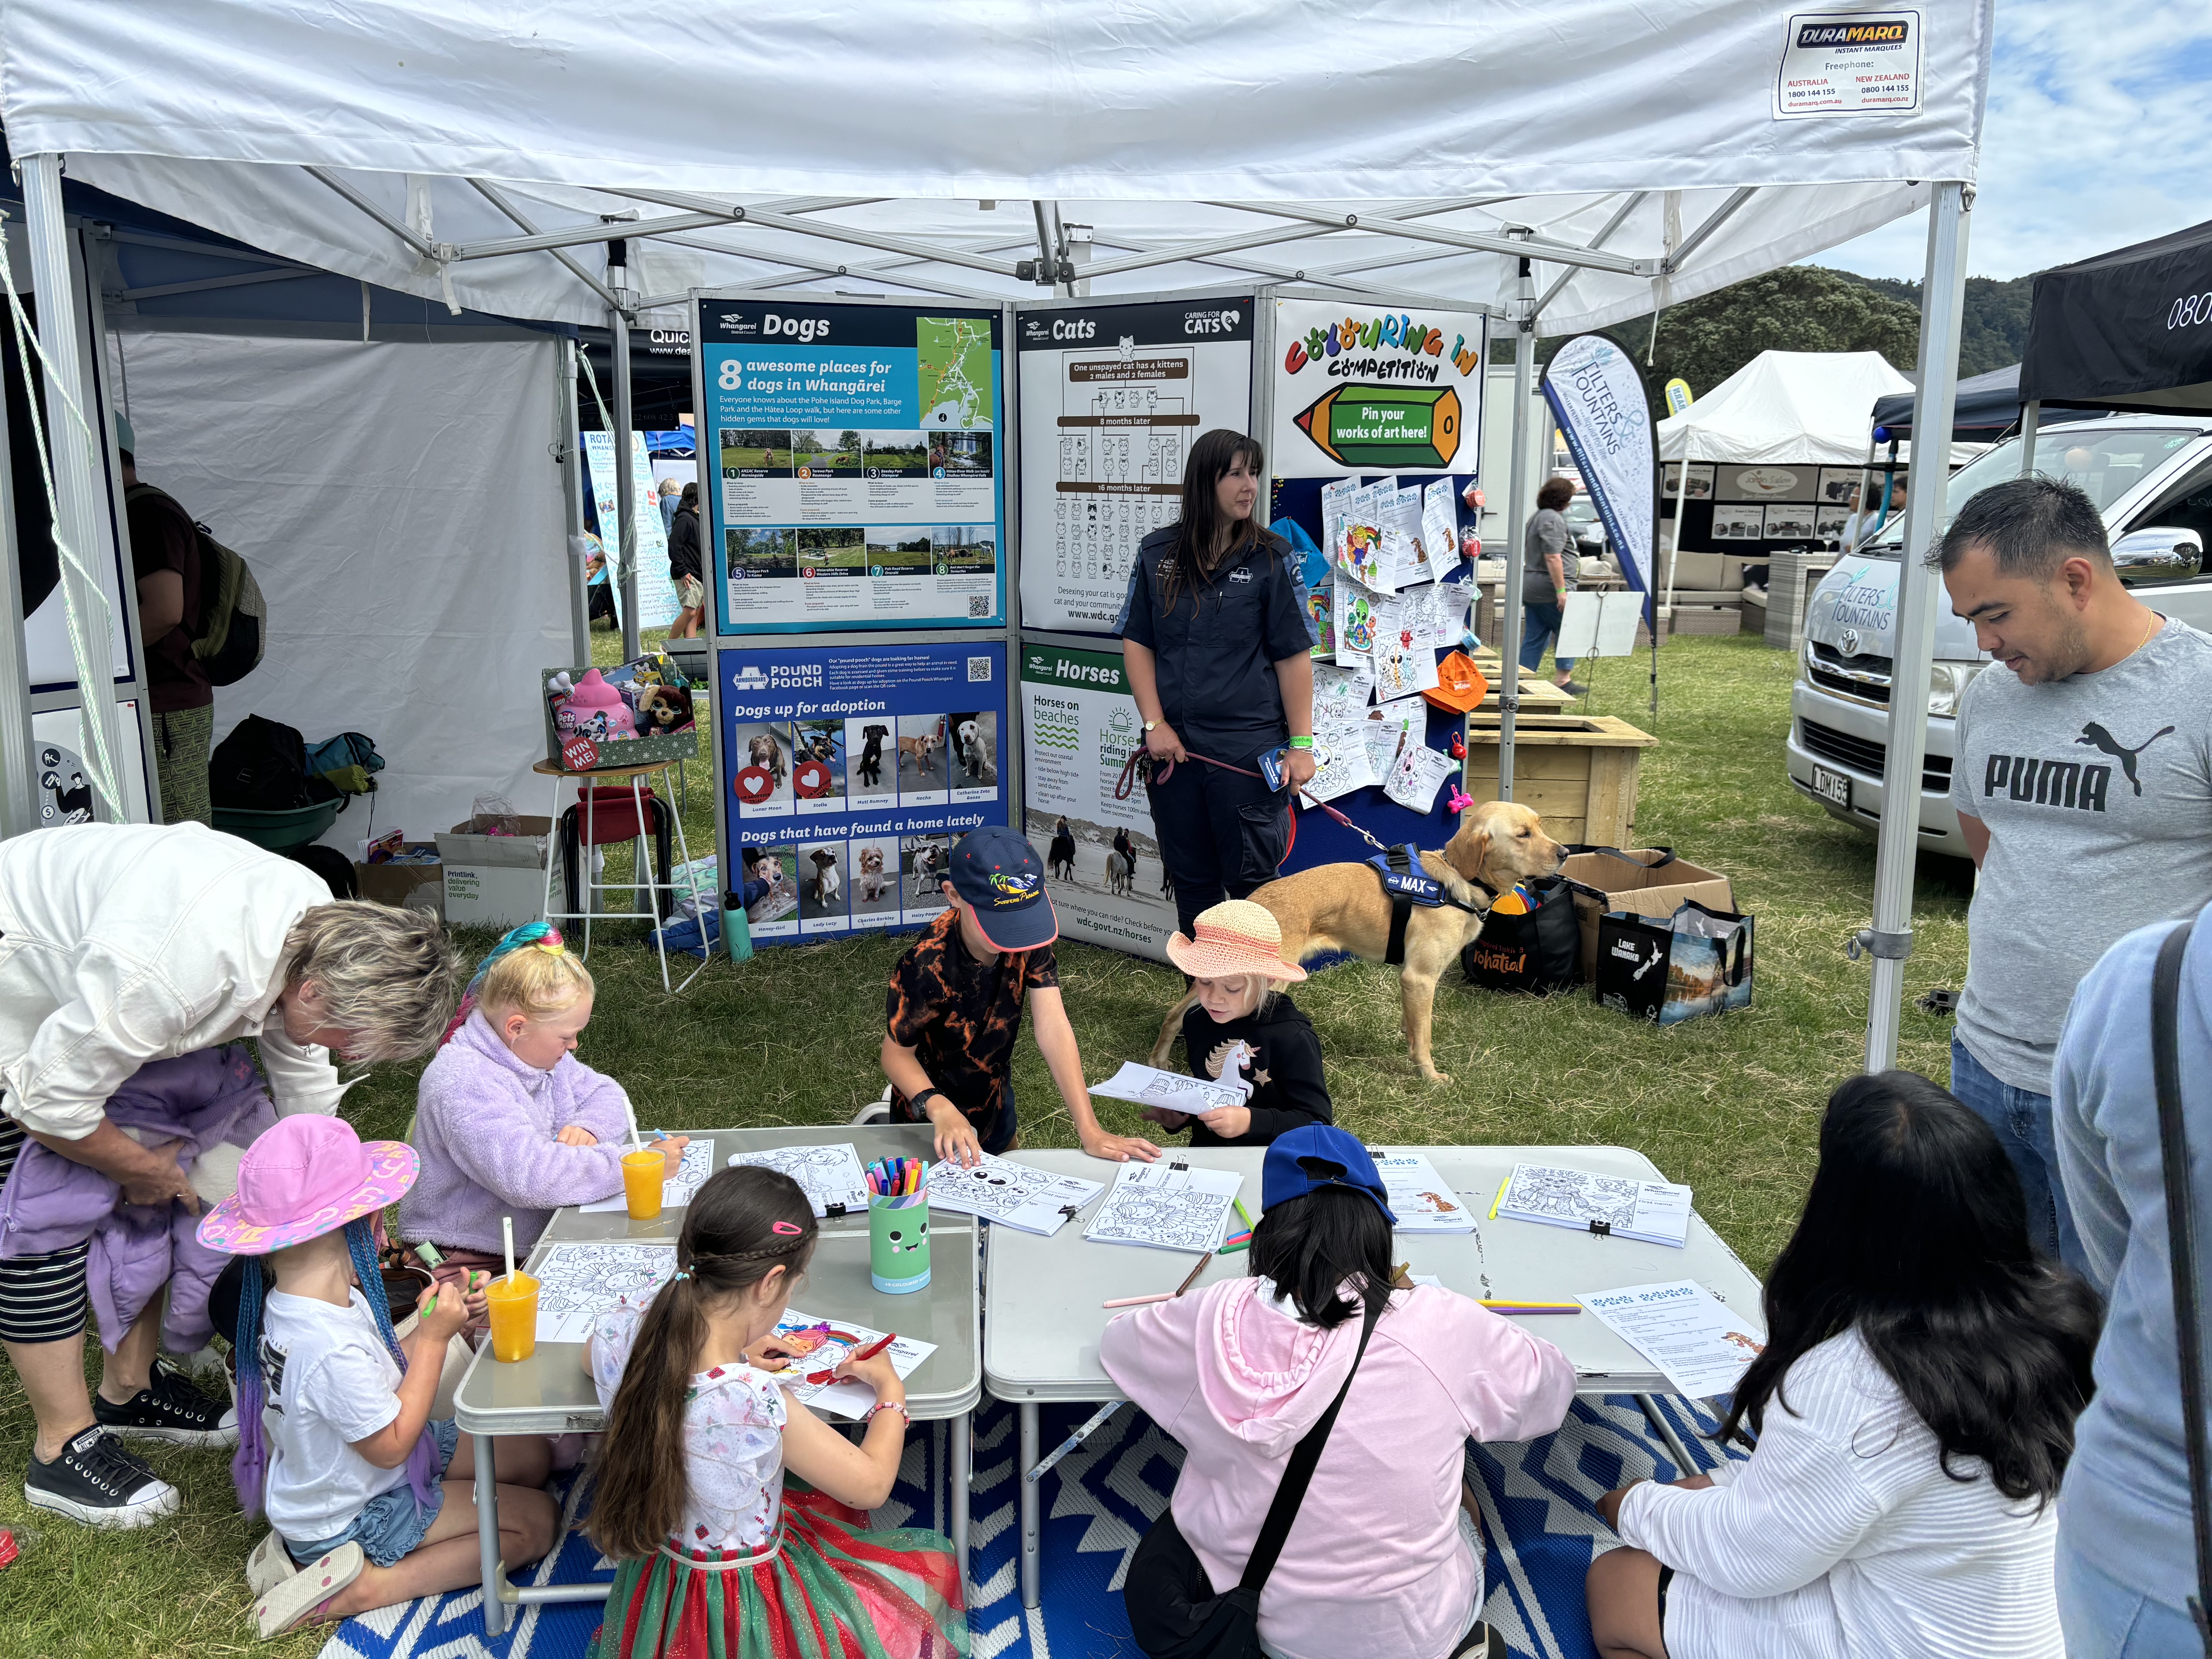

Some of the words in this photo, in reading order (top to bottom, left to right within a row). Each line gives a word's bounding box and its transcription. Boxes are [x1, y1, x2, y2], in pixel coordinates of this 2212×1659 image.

[1800, 26, 1903, 44] DURAMARQ
[1864, 44, 1903, 52] MARQUEES
[1825, 61, 1874, 71] Freephone:
[1788, 78, 1828, 88] AUSTRALIA
[1874, 73, 1910, 82] ZEALAND
[1788, 98, 1842, 107] duramarq.com.au
[2167, 292, 2212, 330] 080
[763, 314, 831, 342] Dogs
[1026, 329, 1049, 337] Whangarei
[1052, 318, 1097, 340] Cats
[1185, 318, 1220, 335] CATS
[650, 329, 691, 343] Quic
[1285, 314, 1444, 374] COLOURING
[1089, 363, 1121, 373] unspayed
[1156, 360, 1184, 368] kittens
[1327, 357, 1439, 383] COMPETITION
[718, 359, 742, 390] 8
[746, 361, 816, 372] awesome
[819, 360, 867, 376] places
[869, 361, 892, 377] for
[1095, 371, 1115, 379] males
[1137, 369, 1166, 378] females
[747, 378, 783, 394] dogs
[787, 378, 801, 391] in
[805, 379, 886, 395] Whangārei
[1583, 361, 1623, 424] FILTERS
[720, 396, 752, 404] Everyone
[1133, 417, 1151, 425] later
[1362, 407, 1379, 420] Pin
[1380, 409, 1405, 426] your
[1336, 426, 1369, 439] works
[1371, 425, 1383, 439] of
[1384, 427, 1400, 438] art
[1401, 426, 1427, 438] here!
[730, 469, 735, 477] 1
[801, 469, 808, 477] 2
[870, 469, 877, 478] 3
[935, 469, 943, 478] 4
[735, 569, 742, 578] 5
[805, 568, 812, 577] 6
[874, 567, 881, 576] 7
[939, 565, 946, 574] 8
[1058, 586, 1085, 598] Desexing
[1085, 589, 1099, 599] your
[1110, 590, 1115, 598] is
[1838, 585, 1885, 606] FILTERS
[770, 664, 822, 677] POUND
[1029, 663, 1053, 672] Whangarei
[1055, 659, 1120, 685] Horses
[771, 676, 822, 689] POOCH
[554, 698, 566, 707] LEGO
[735, 705, 771, 719] Dogs
[775, 705, 793, 718] up
[795, 701, 819, 717] for
[821, 699, 886, 714] adoption
[1034, 695, 1065, 709] Horses
[1067, 701, 1079, 711] on
[557, 713, 576, 724] Pets
[1034, 706, 1079, 726] beaches
[559, 722, 575, 730] Alive
[564, 740, 591, 759] WIN
[1034, 749, 1049, 757] Protect
[1100, 743, 1126, 759] riding
[573, 750, 596, 769] ME!
[1035, 757, 1061, 766] environment
[1984, 754, 2112, 813] PUMA
[741, 830, 777, 844] Dogs
[780, 826, 811, 840] that
[814, 823, 848, 837] have
[849, 820, 891, 837] found
[895, 822, 903, 831] a
[907, 818, 944, 830] home
[947, 814, 985, 828] lately
[447, 871, 478, 879] Printlink,
[448, 878, 480, 887] delivering
[1400, 876, 1427, 894] MAX
[448, 892, 479, 900] everyday
[1076, 916, 1152, 943] wdc.govt.nz/horses
[1618, 938, 1636, 952] LAKE
[1611, 946, 1640, 963] WANAKA
[891, 1279, 919, 1288] COLOURED
[78, 1430, 99, 1444] CONVERSE
